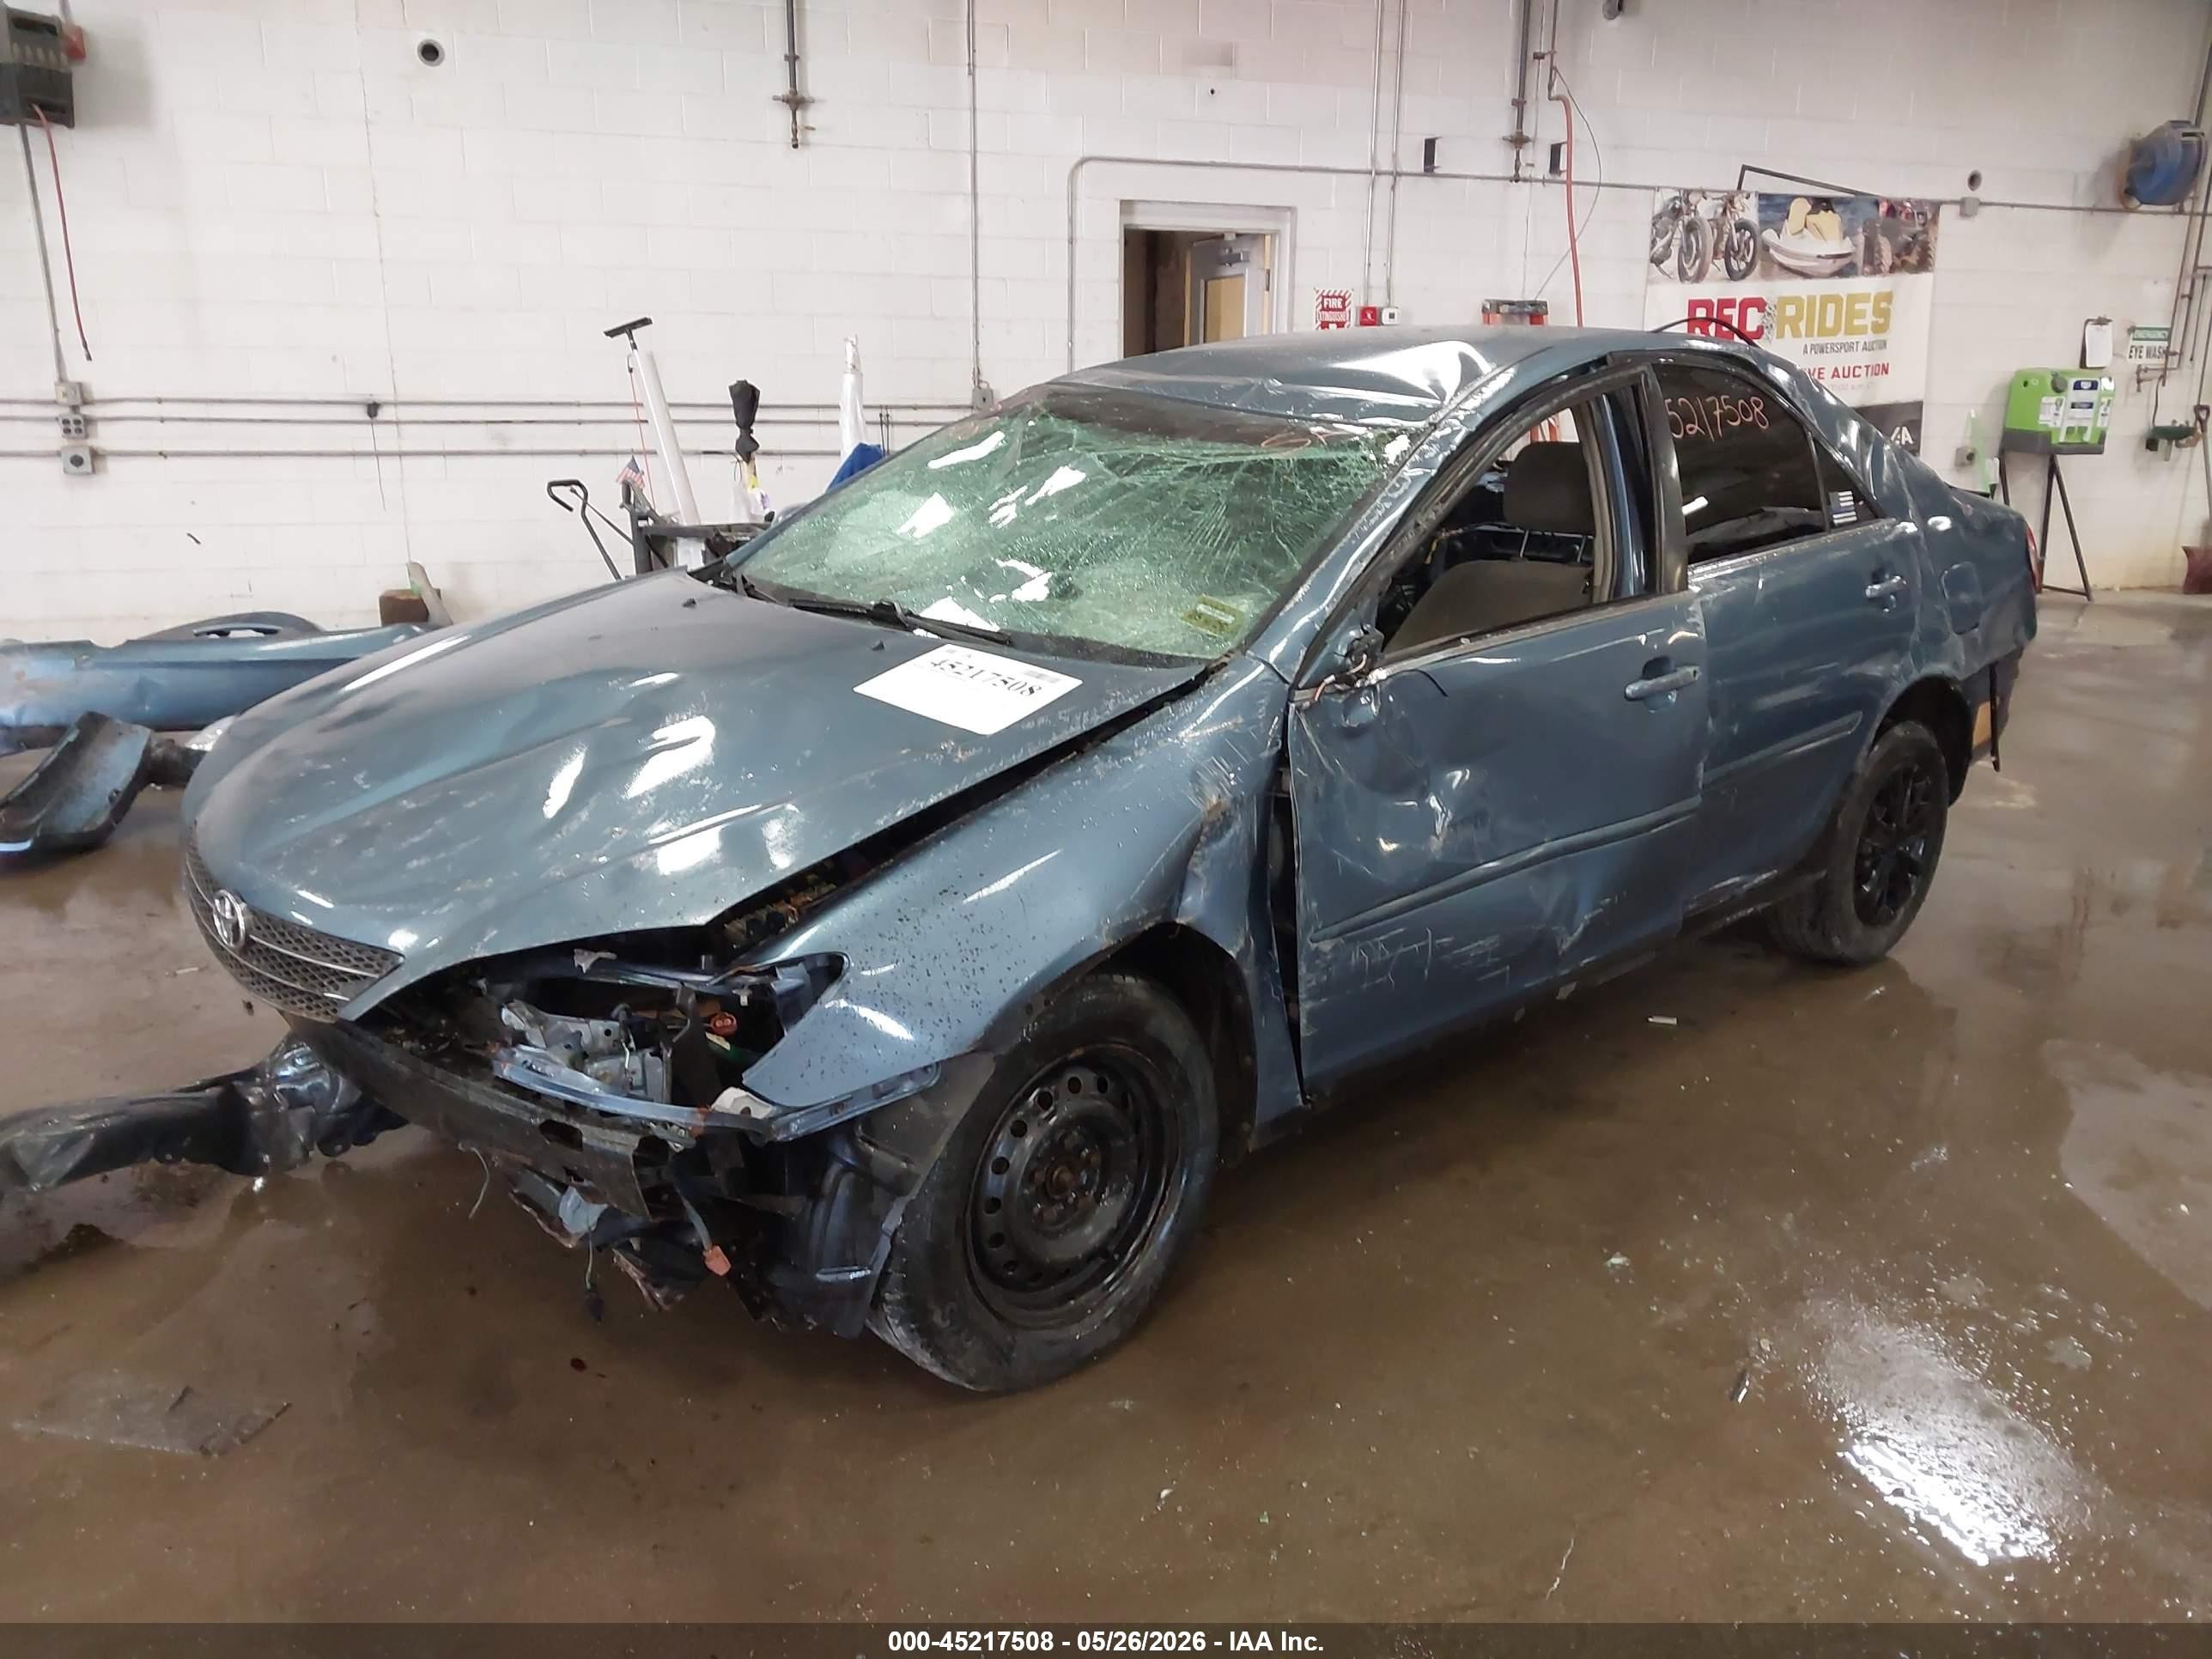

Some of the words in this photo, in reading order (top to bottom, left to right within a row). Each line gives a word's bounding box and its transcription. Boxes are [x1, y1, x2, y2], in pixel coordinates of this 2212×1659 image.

[1323, 297, 1344, 309] FIRE
[1688, 297, 1766, 341] REC
[1776, 291, 1893, 339] RIDES
[1803, 344, 1809, 356] A
[1810, 342, 1860, 356] POWERSPORT
[2129, 345, 2144, 359] EYE
[1831, 362, 1890, 380] AUCTION
